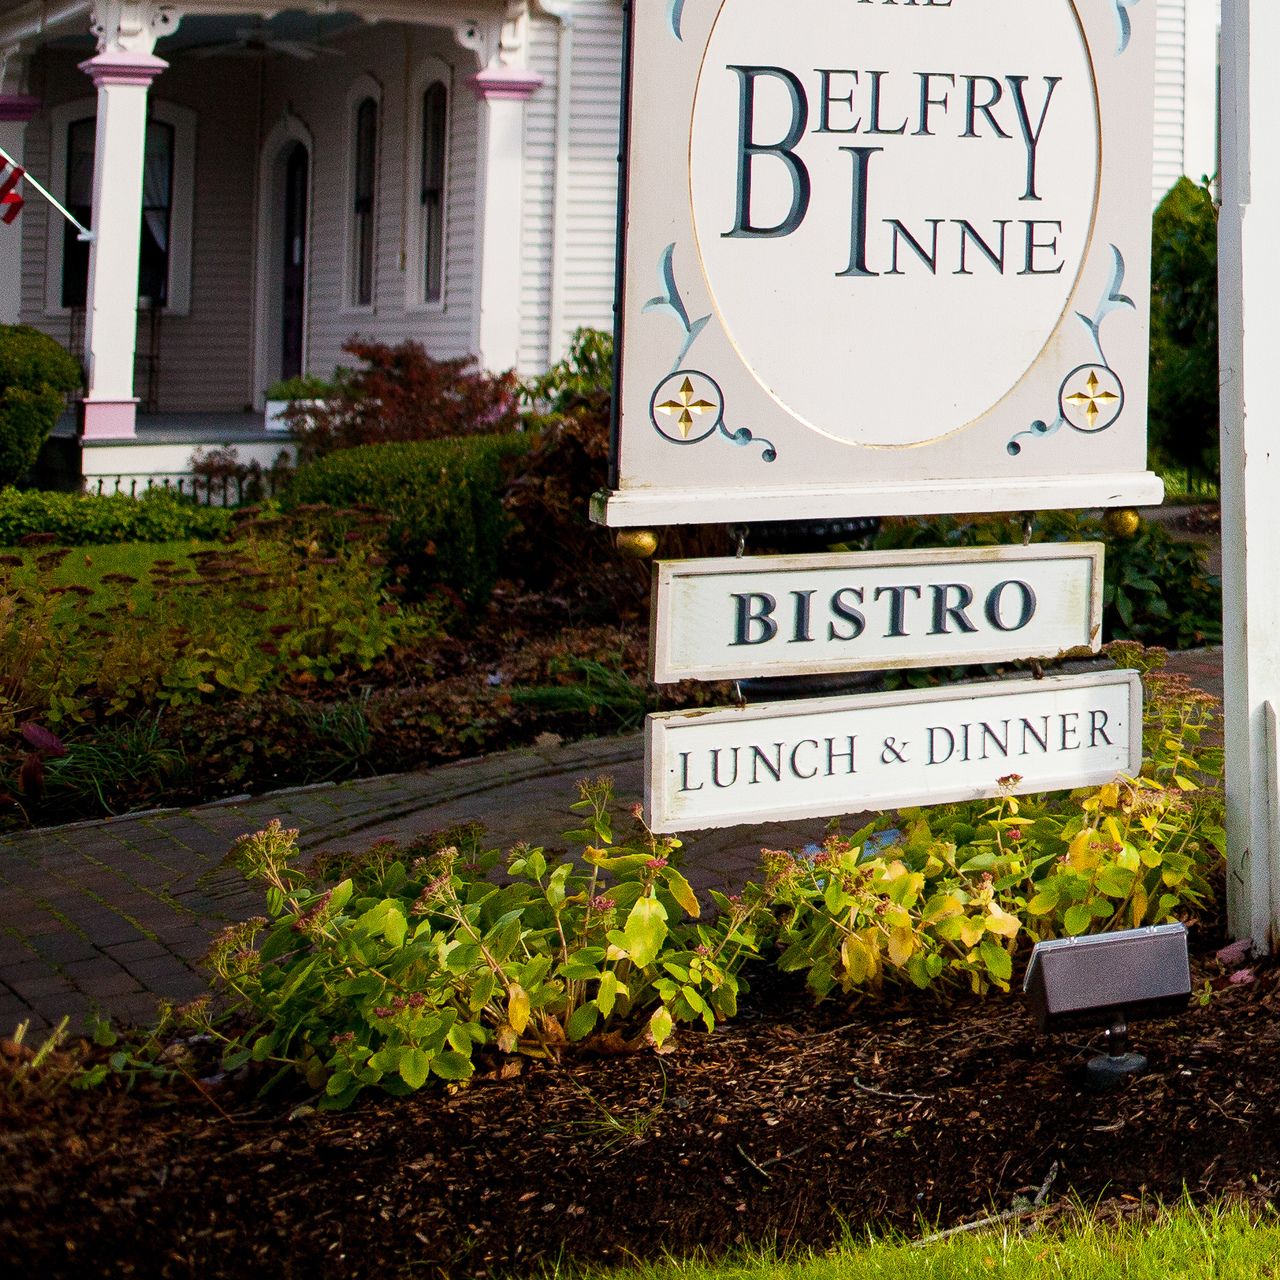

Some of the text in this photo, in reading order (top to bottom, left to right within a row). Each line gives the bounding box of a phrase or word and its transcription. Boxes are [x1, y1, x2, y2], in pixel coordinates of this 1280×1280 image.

[720, 64, 1062, 238] BELFRY
[834, 146, 1065, 277] INNE
[728, 579, 1037, 647] BISTRO
[677, 708, 1113, 792] LUNCH & DINNER
